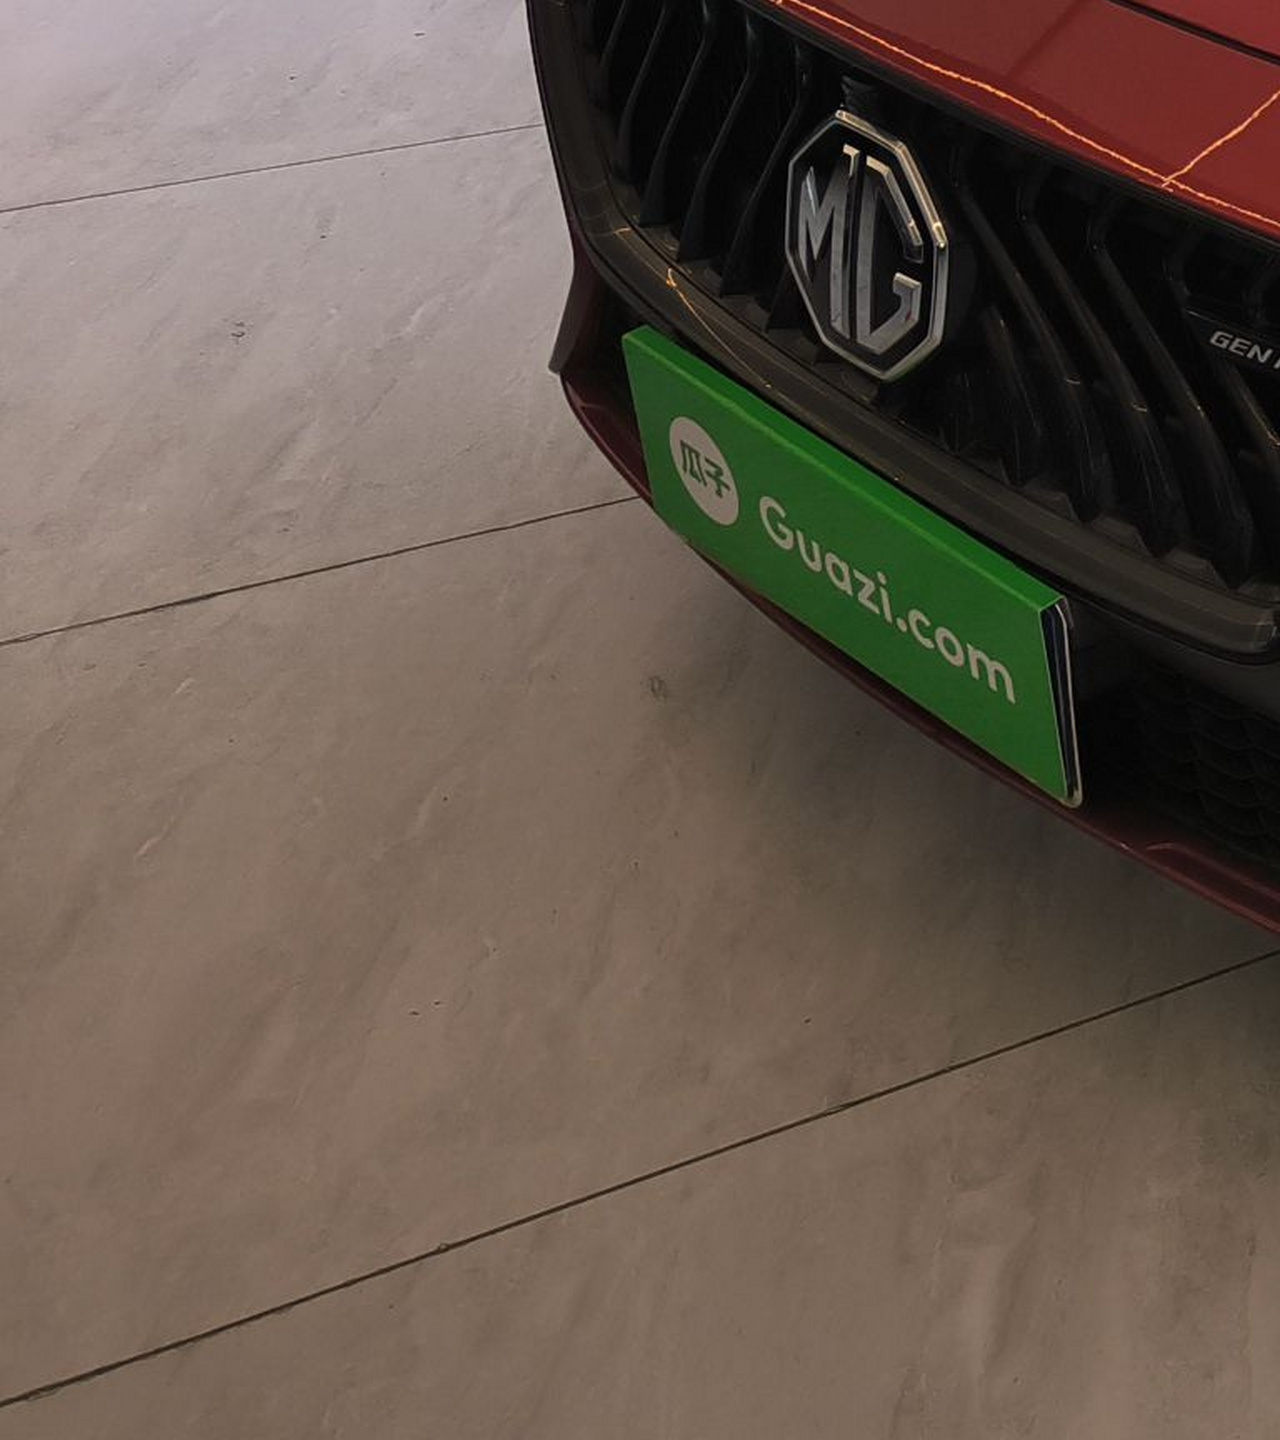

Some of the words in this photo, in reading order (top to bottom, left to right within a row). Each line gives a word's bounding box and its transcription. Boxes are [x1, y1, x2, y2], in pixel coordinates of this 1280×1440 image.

[799, 143, 924, 356] MG
[1210, 330, 1273, 363] GEN
[679, 439, 732, 499] 瓜子
[758, 495, 1016, 705] Guazi.com
